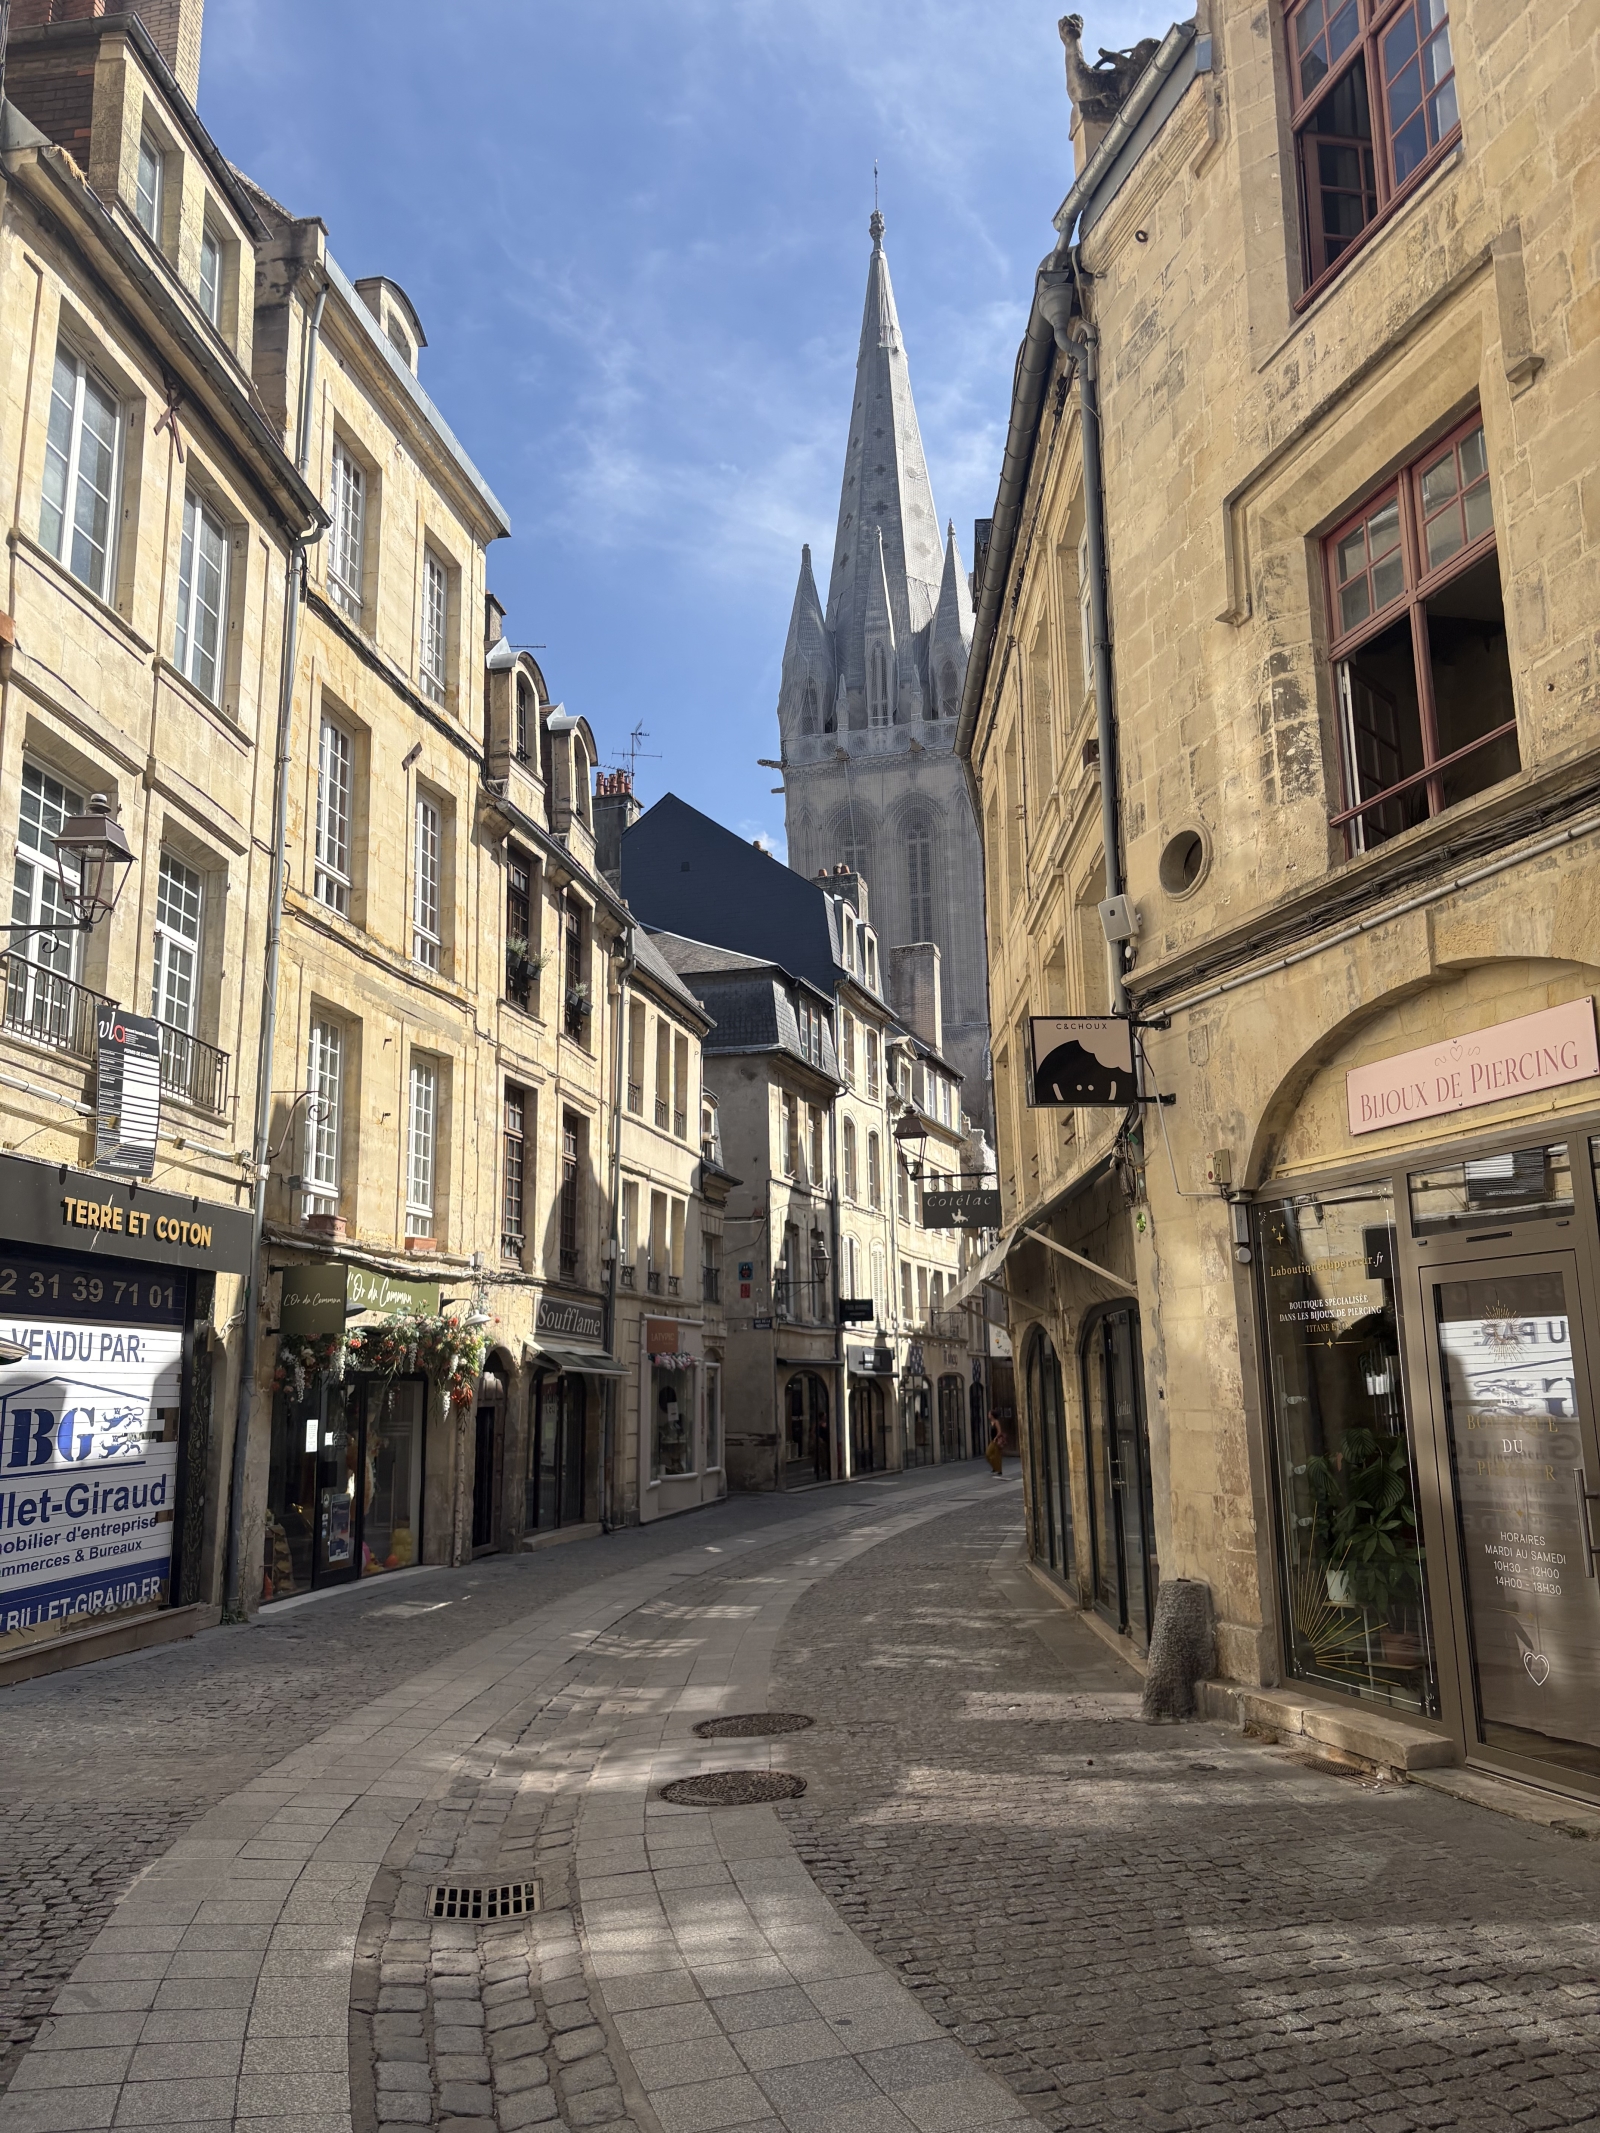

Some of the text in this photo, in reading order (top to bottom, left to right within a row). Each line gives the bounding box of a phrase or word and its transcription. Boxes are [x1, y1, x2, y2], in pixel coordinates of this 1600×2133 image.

[99, 1011, 125, 1043] vla
[1056, 1022, 1108, 1030] C&CHOUX
[1360, 1040, 1578, 1122] BIJOUX DE PIERCING
[927, 1194, 992, 1207] Cotélac
[64, 1196, 212, 1247] TERRE ET COTON
[28, 1271, 60, 1299] 31
[72, 1276, 104, 1303] 39
[112, 1281, 139, 1306] 71
[149, 1285, 174, 1309] 01
[1280, 1305, 1382, 1322] DANS LES BIJOUX DE PIERCING
[1289, 1299, 1323, 1310] BOUTIQUE
[537, 1303, 601, 1335] Soufflame
[1305, 1323, 1331, 1332] TITANE
[12, 1328, 146, 1363] VENDU PAR:
[7, 1407, 96, 1468] BG
[1502, 1438, 1523, 1454] DU
[0, 1516, 158, 1556] obilier d'entreprise
[1501, 1531, 1546, 1546] HORAIRES
[0, 1540, 142, 1577] mmerces & Bureaux
[1485, 1544, 1566, 1564] MARDI AU SAMEDI
[1494, 1561, 1520, 1573] 10H30
[1531, 1566, 1559, 1579] 12H00
[1495, 1576, 1522, 1589] 14H00
[1533, 1582, 1561, 1595] 18H30
